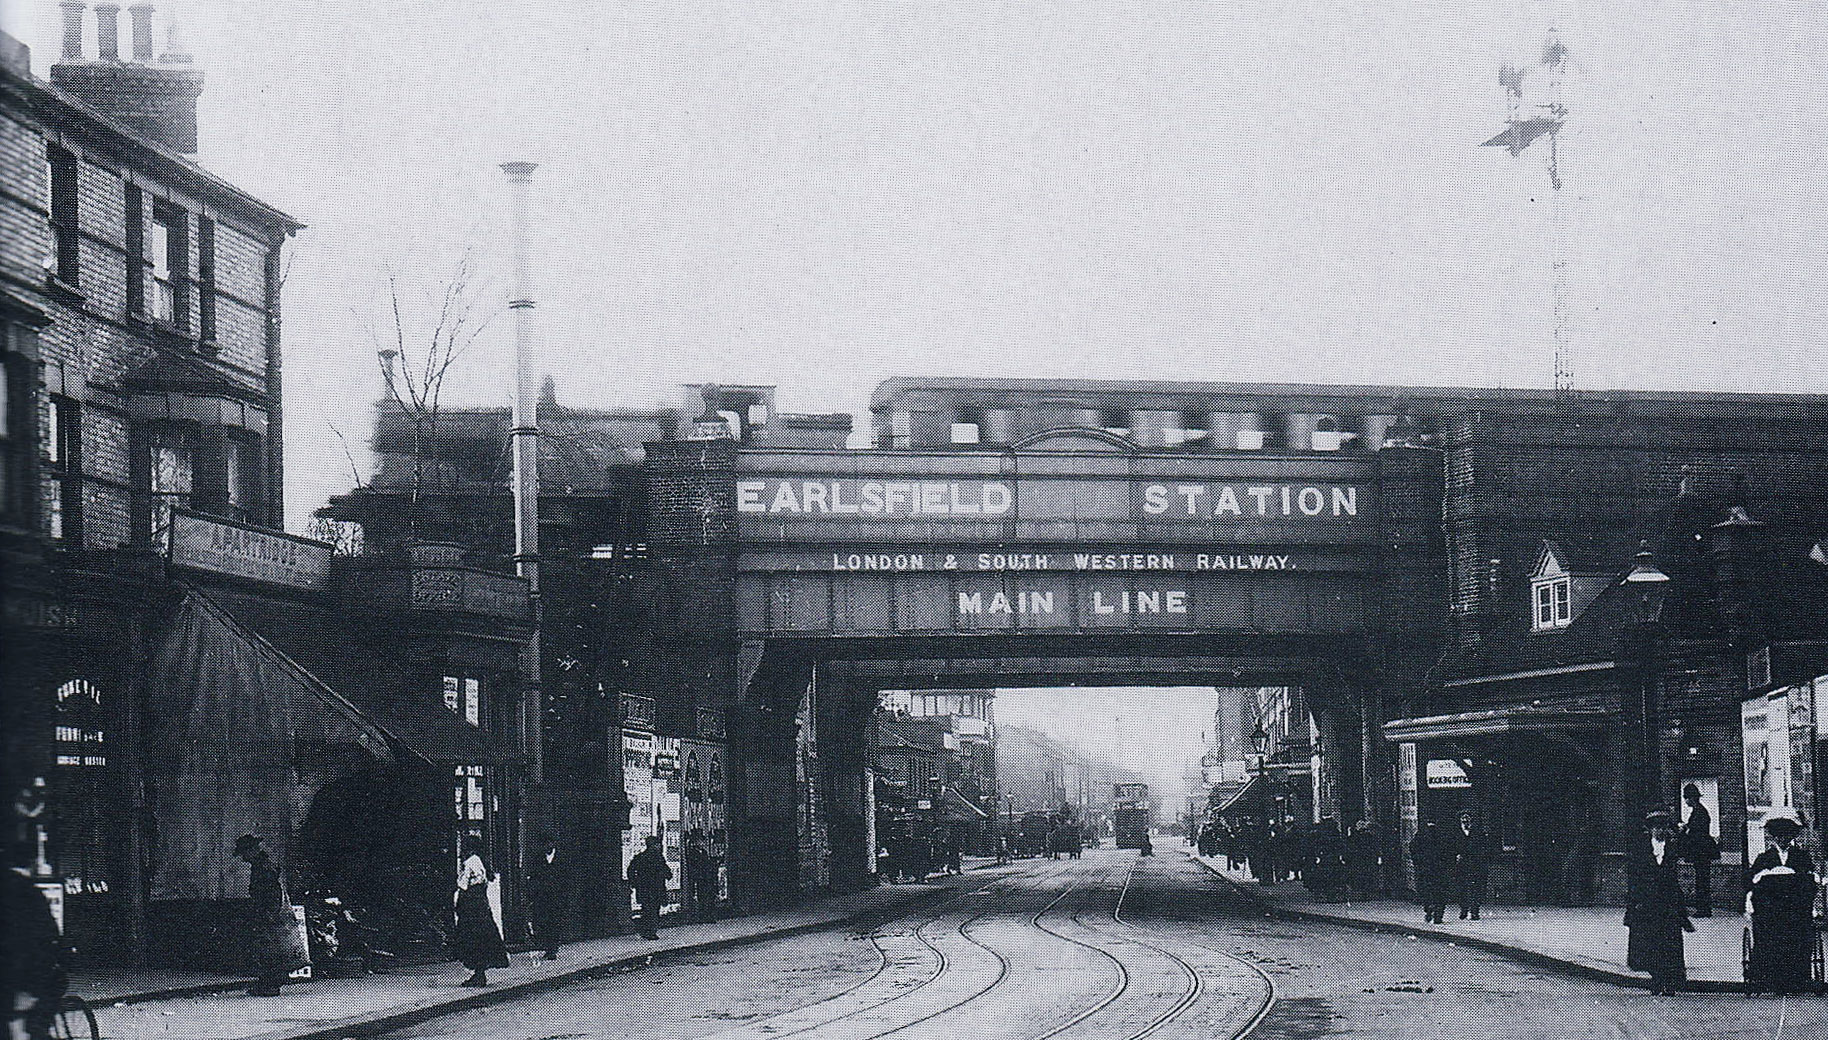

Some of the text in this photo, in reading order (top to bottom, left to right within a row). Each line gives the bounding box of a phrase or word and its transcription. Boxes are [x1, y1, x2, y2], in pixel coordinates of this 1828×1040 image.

[736, 481, 1358, 516] EARLSFIELD STATION
[834, 553, 1297, 571] LONDON & SOUTH WESTERN RAILWAY.
[958, 590, 1188, 615] MAIN LINE
